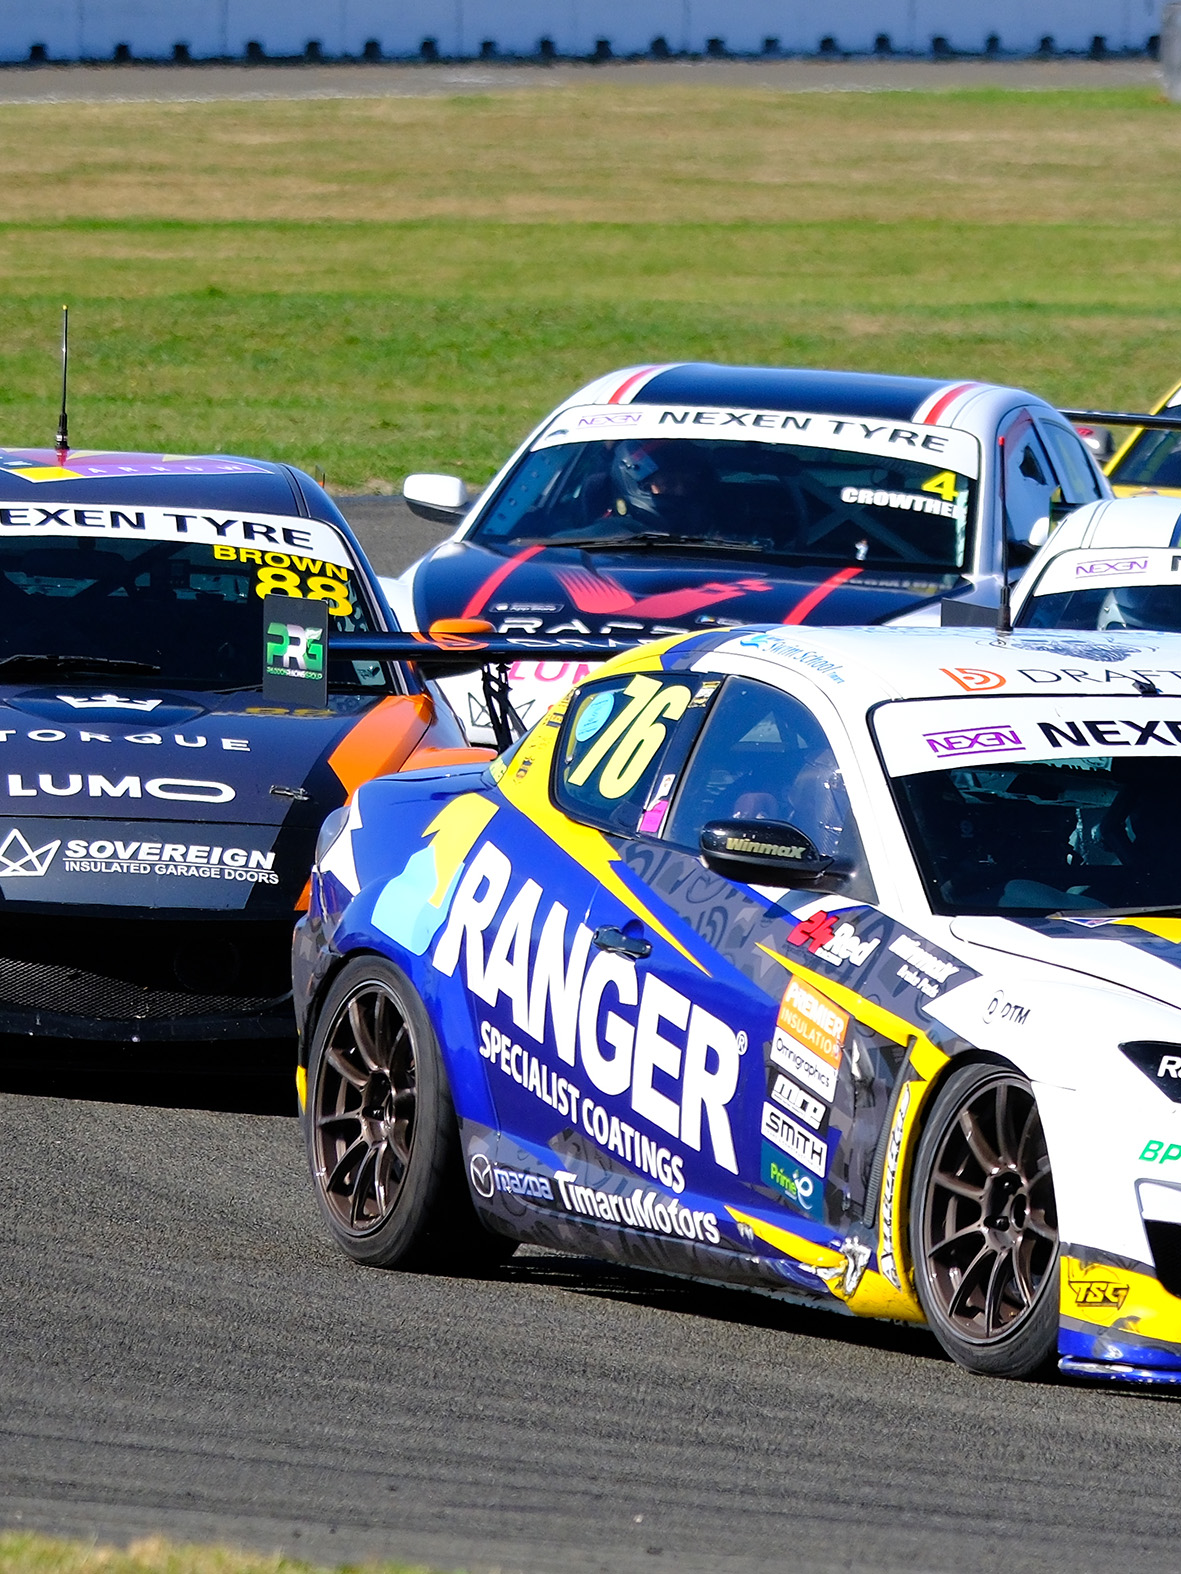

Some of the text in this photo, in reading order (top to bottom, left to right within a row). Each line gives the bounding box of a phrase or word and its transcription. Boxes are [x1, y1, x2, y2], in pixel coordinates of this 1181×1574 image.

[658, 411, 812, 431] NEXEN
[823, 420, 950, 454] TYRE
[921, 470, 959, 502] 4
[163, 512, 314, 551] TYRE
[213, 544, 348, 581] BROWN
[255, 566, 353, 617] 88
[567, 673, 692, 799] 76
[925, 726, 1024, 757] NEXEN
[8, 774, 236, 803] LUMO
[64, 839, 276, 870] SOVEREIGN
[65, 860, 279, 885] INSULATED GARAGE DOORS
[785, 981, 845, 1040] PREMIER
[781, 1007, 841, 1059] INSULATION
[479, 1020, 685, 1194] SPECIALIST COATINGS
[493, 1165, 555, 1201] mazda
[770, 1161, 797, 1195] Prime
